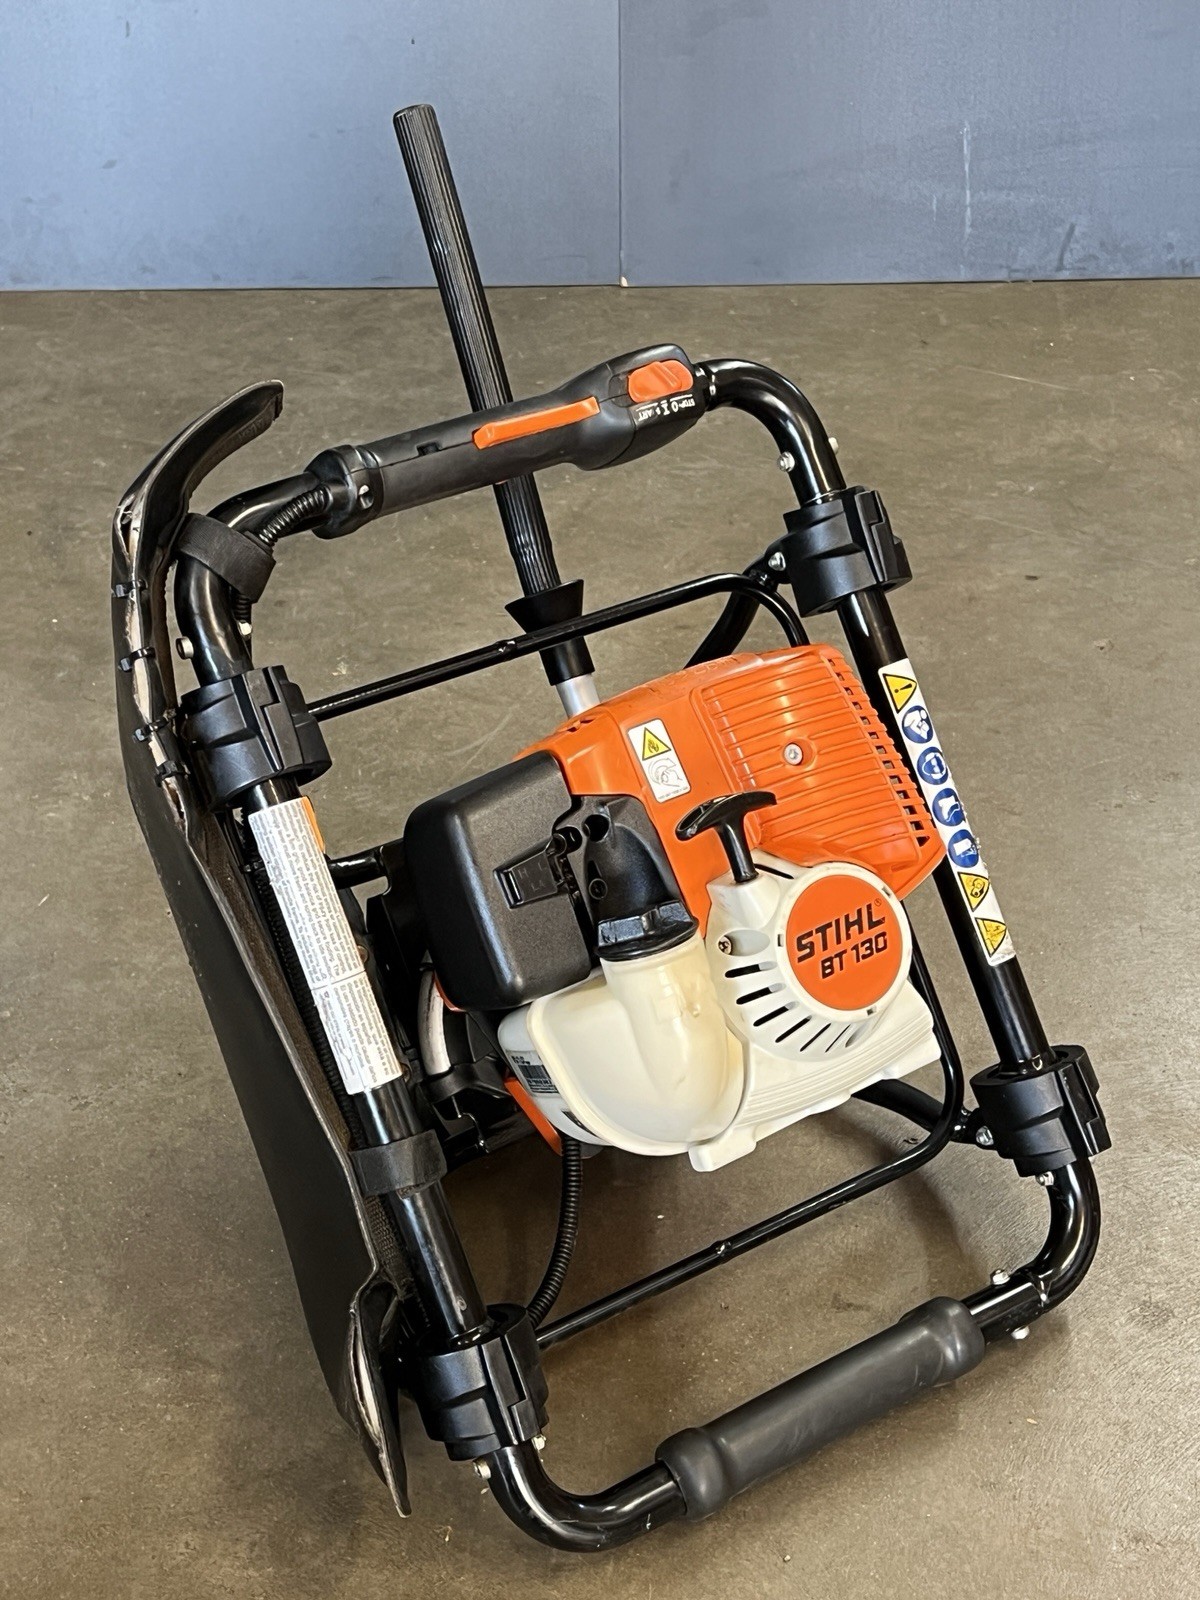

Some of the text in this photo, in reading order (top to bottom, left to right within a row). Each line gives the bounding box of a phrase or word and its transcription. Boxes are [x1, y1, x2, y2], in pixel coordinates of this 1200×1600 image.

[638, 407, 661, 421] SART
[797, 903, 885, 963] STIHL
[821, 931, 887, 979] BT 130
